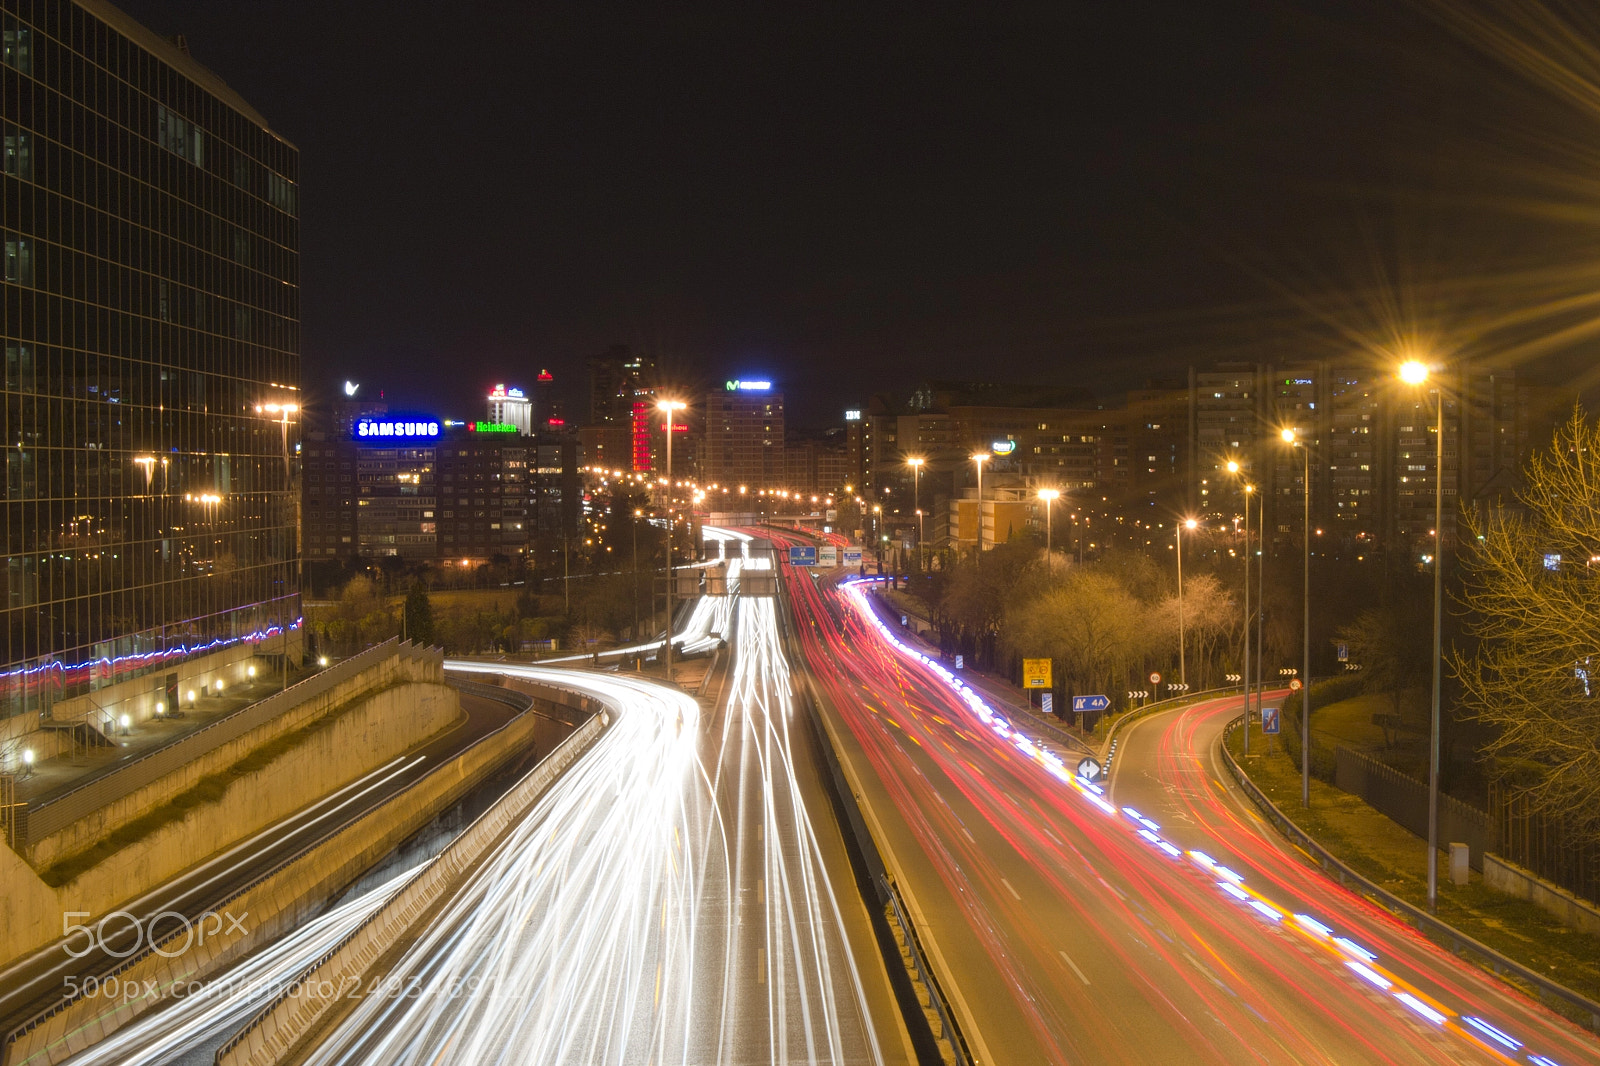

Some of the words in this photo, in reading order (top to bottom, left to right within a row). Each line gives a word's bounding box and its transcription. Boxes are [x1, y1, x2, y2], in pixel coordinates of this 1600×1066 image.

[358, 422, 439, 436] SAMSUNG
[476, 421, 517, 433] Heineken
[1091, 698, 1104, 707] 4A
